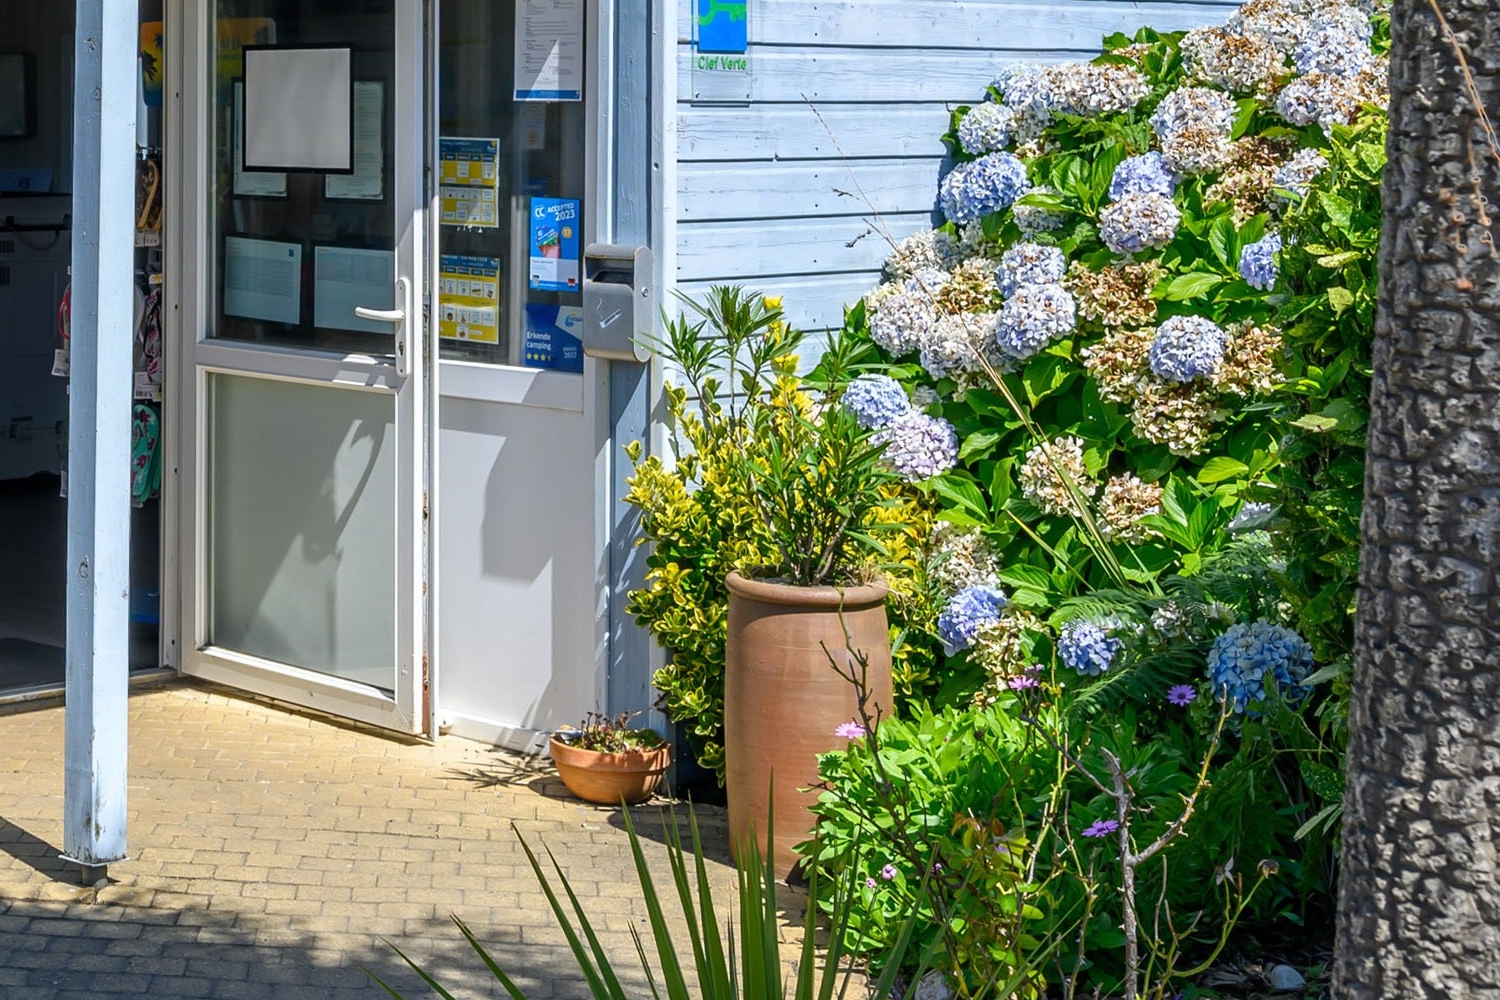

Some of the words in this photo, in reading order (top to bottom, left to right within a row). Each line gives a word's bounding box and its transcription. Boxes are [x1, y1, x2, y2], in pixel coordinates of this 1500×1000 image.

[698, 55, 719, 70] Clef
[720, 55, 747, 70] Verte
[547, 202, 575, 214] ACCEPTED
[555, 209, 575, 221] 2023
[526, 331, 551, 340] Erkende
[526, 341, 551, 351] camping
